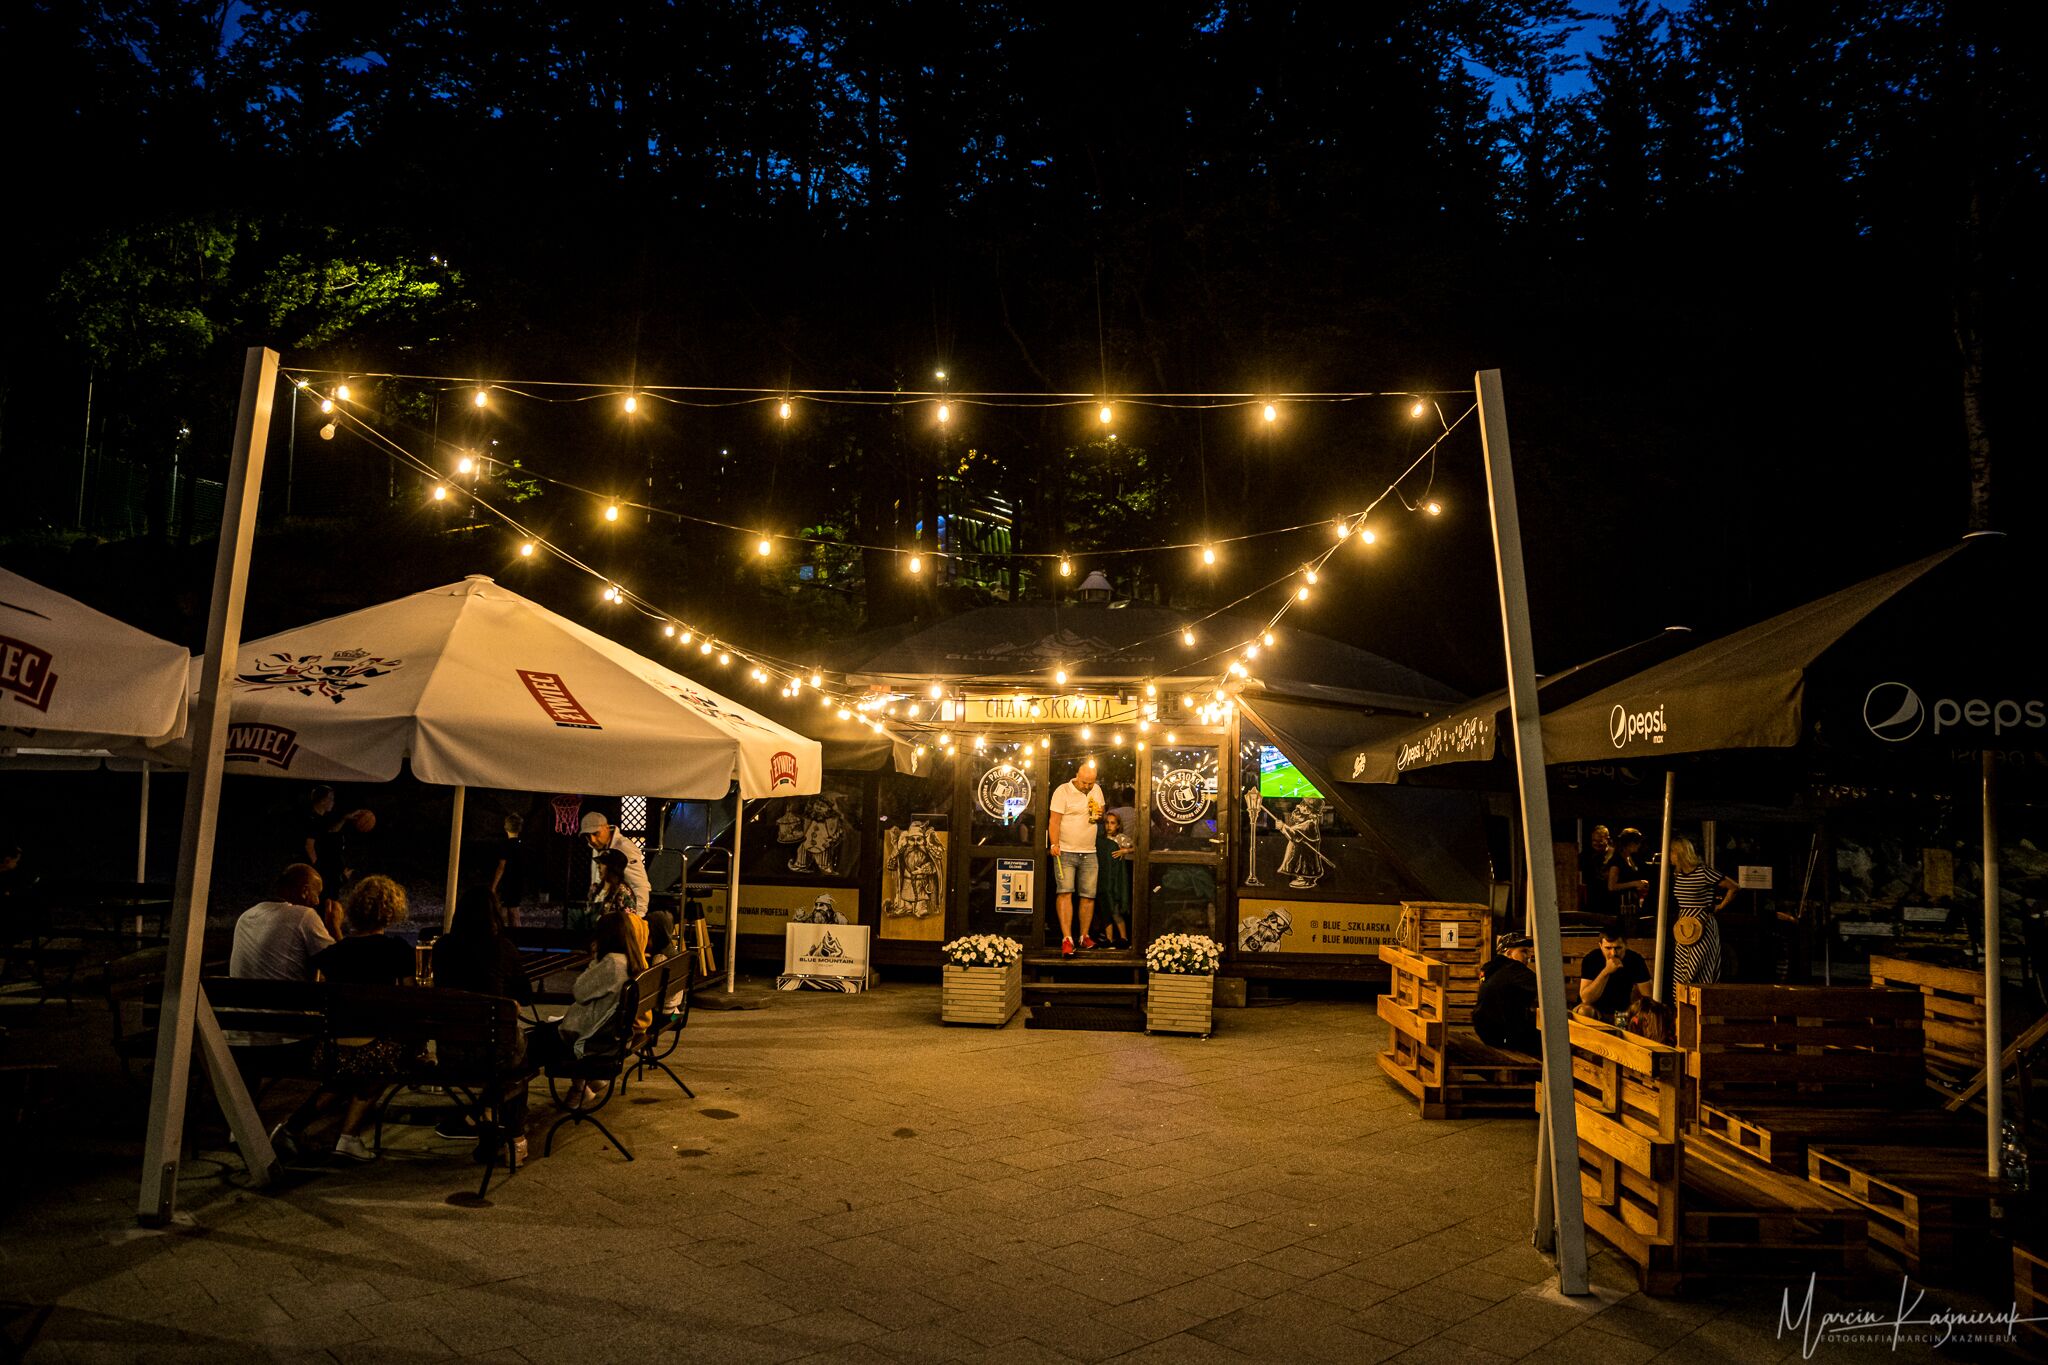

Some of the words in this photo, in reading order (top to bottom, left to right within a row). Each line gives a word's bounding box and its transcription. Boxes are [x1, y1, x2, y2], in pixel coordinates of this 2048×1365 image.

[527, 673, 588, 722] ŻYWIEC
[1628, 703, 1664, 743] pepsi
[1933, 698, 2048, 736] peps
[227, 727, 288, 755] YWIEC
[1322, 934, 1341, 944] BLUE
[1343, 935, 1380, 945] MOUNTAIN
